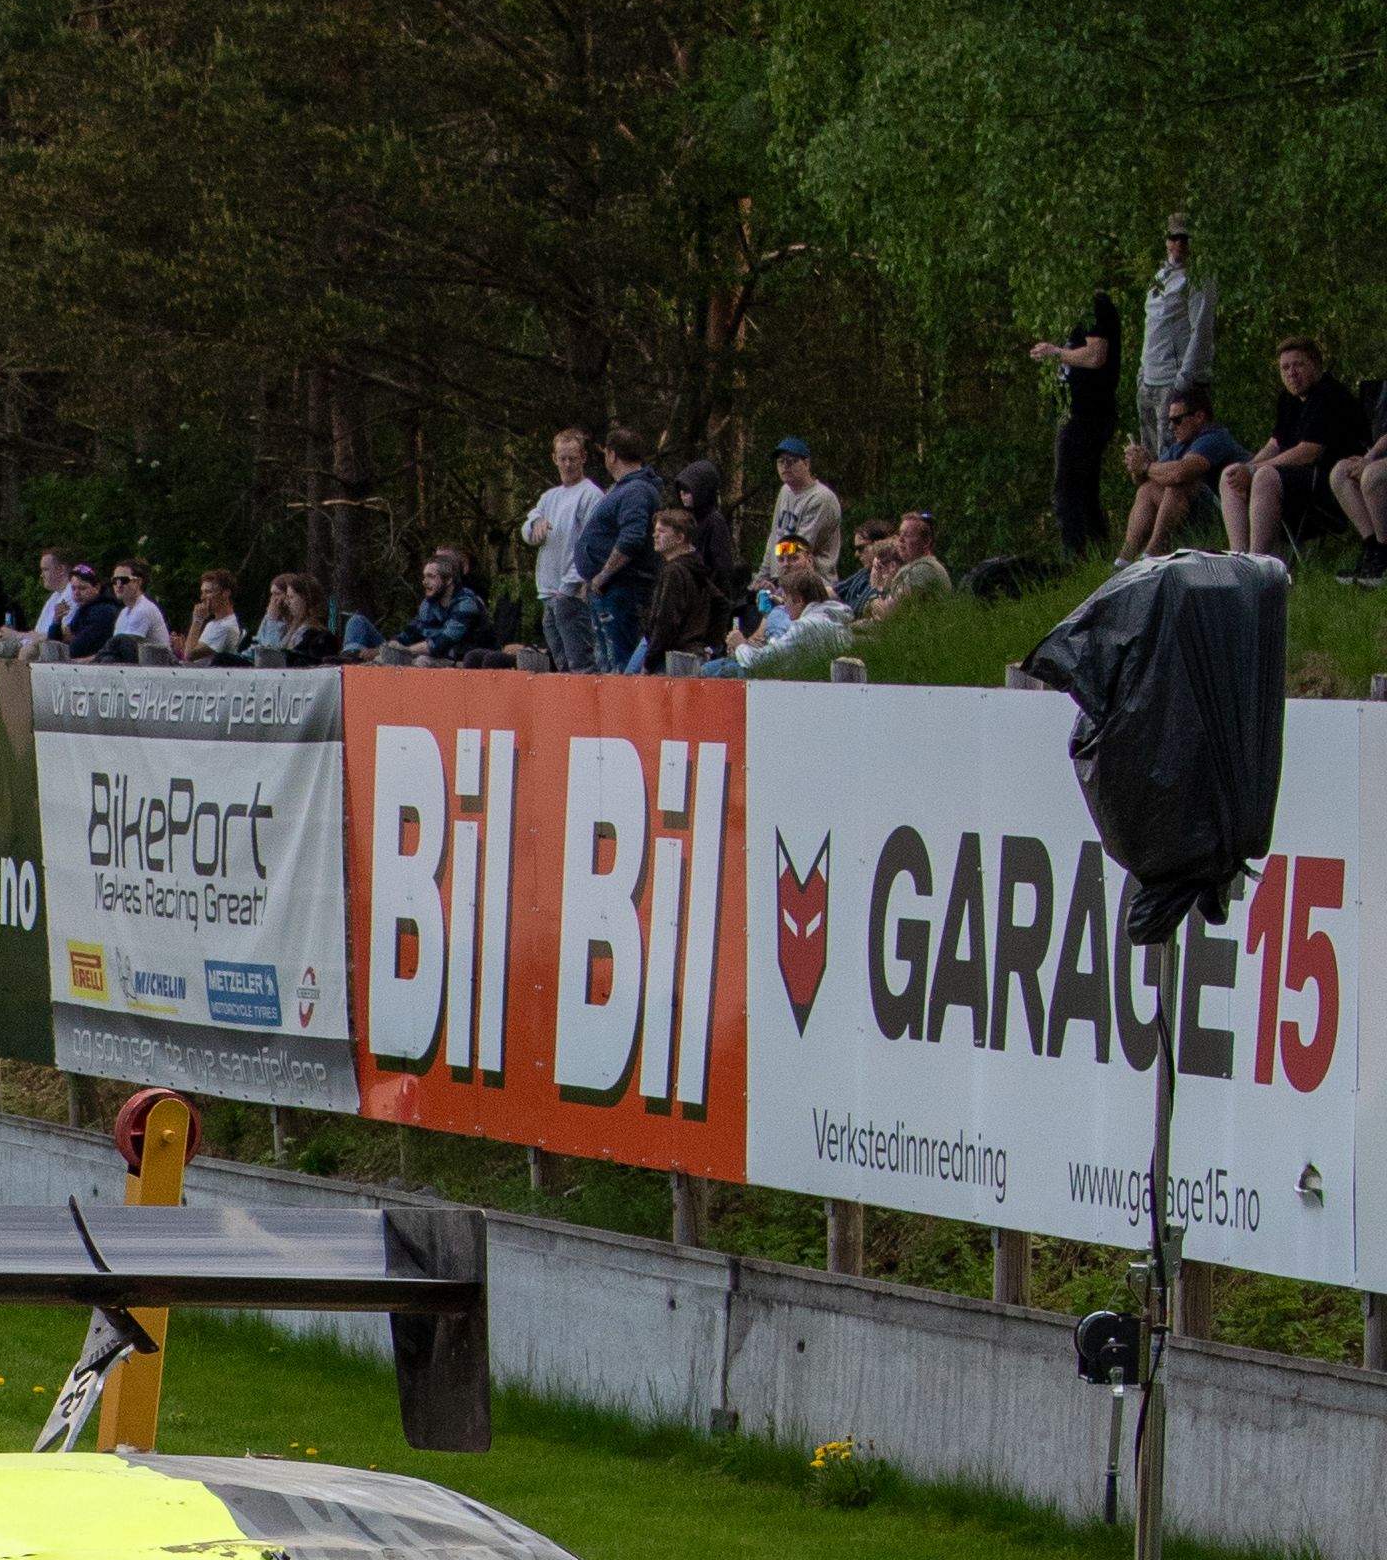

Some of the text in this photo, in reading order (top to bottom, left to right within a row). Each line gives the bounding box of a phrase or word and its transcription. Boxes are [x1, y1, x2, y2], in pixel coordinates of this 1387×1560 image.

[88, 772, 274, 880] BikePort
[94, 872, 269, 933] Makes Racing Great!
[369, 725, 729, 1114] Bil Bil
[69, 951, 104, 992] PIRELLI
[134, 970, 187, 1000] MICHELIN
[208, 969, 264, 995] METZELER
[812, 1106, 1008, 1204] Verkstedinnredning
[1068, 1160, 1261, 1233] www.gaage15.no
